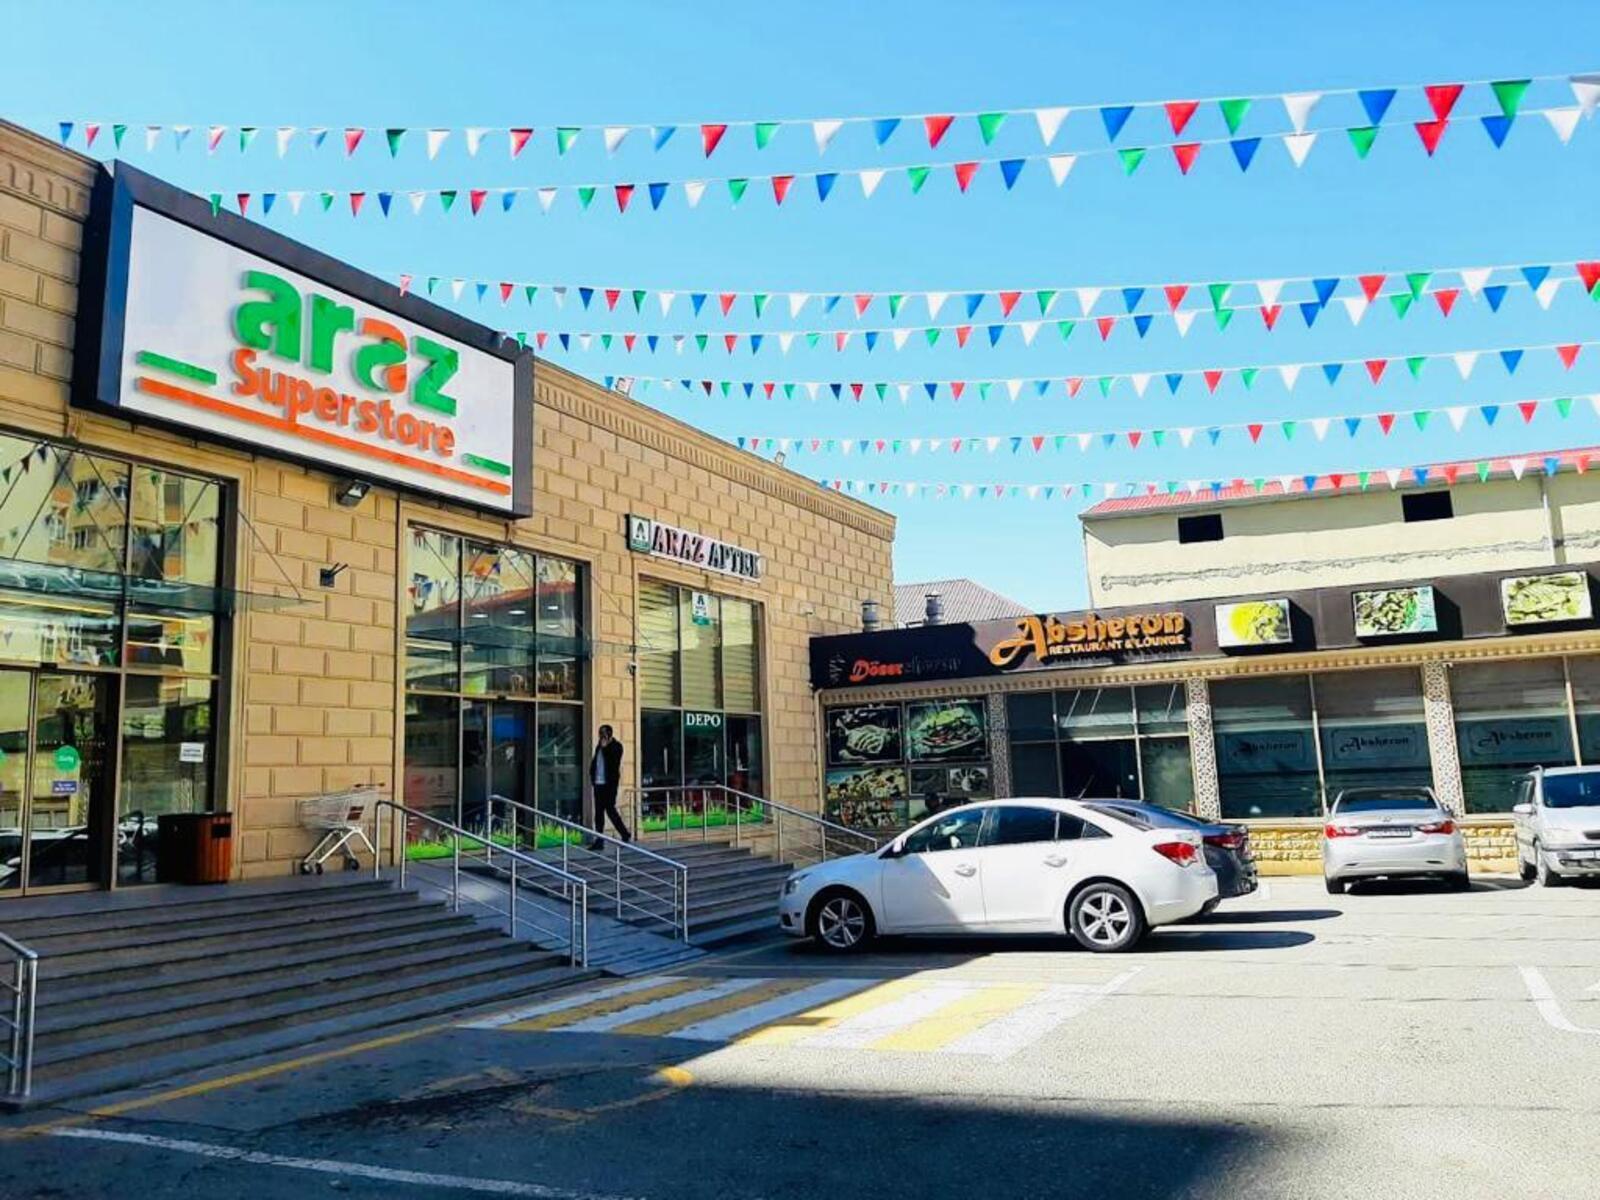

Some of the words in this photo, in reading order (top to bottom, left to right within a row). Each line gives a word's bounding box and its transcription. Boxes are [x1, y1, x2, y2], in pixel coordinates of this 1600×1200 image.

[233, 270, 459, 417] araz
[231, 348, 456, 457] Superstore
[652, 525, 704, 563] ARAZ
[707, 541, 760, 579] APTEK
[989, 612, 1185, 668] Absheron
[1049, 639, 1123, 656] RESTAURANT
[1137, 633, 1186, 649] LOUNGE
[686, 713, 721, 727] DEPO
[1340, 737, 1409, 752] Absheron
